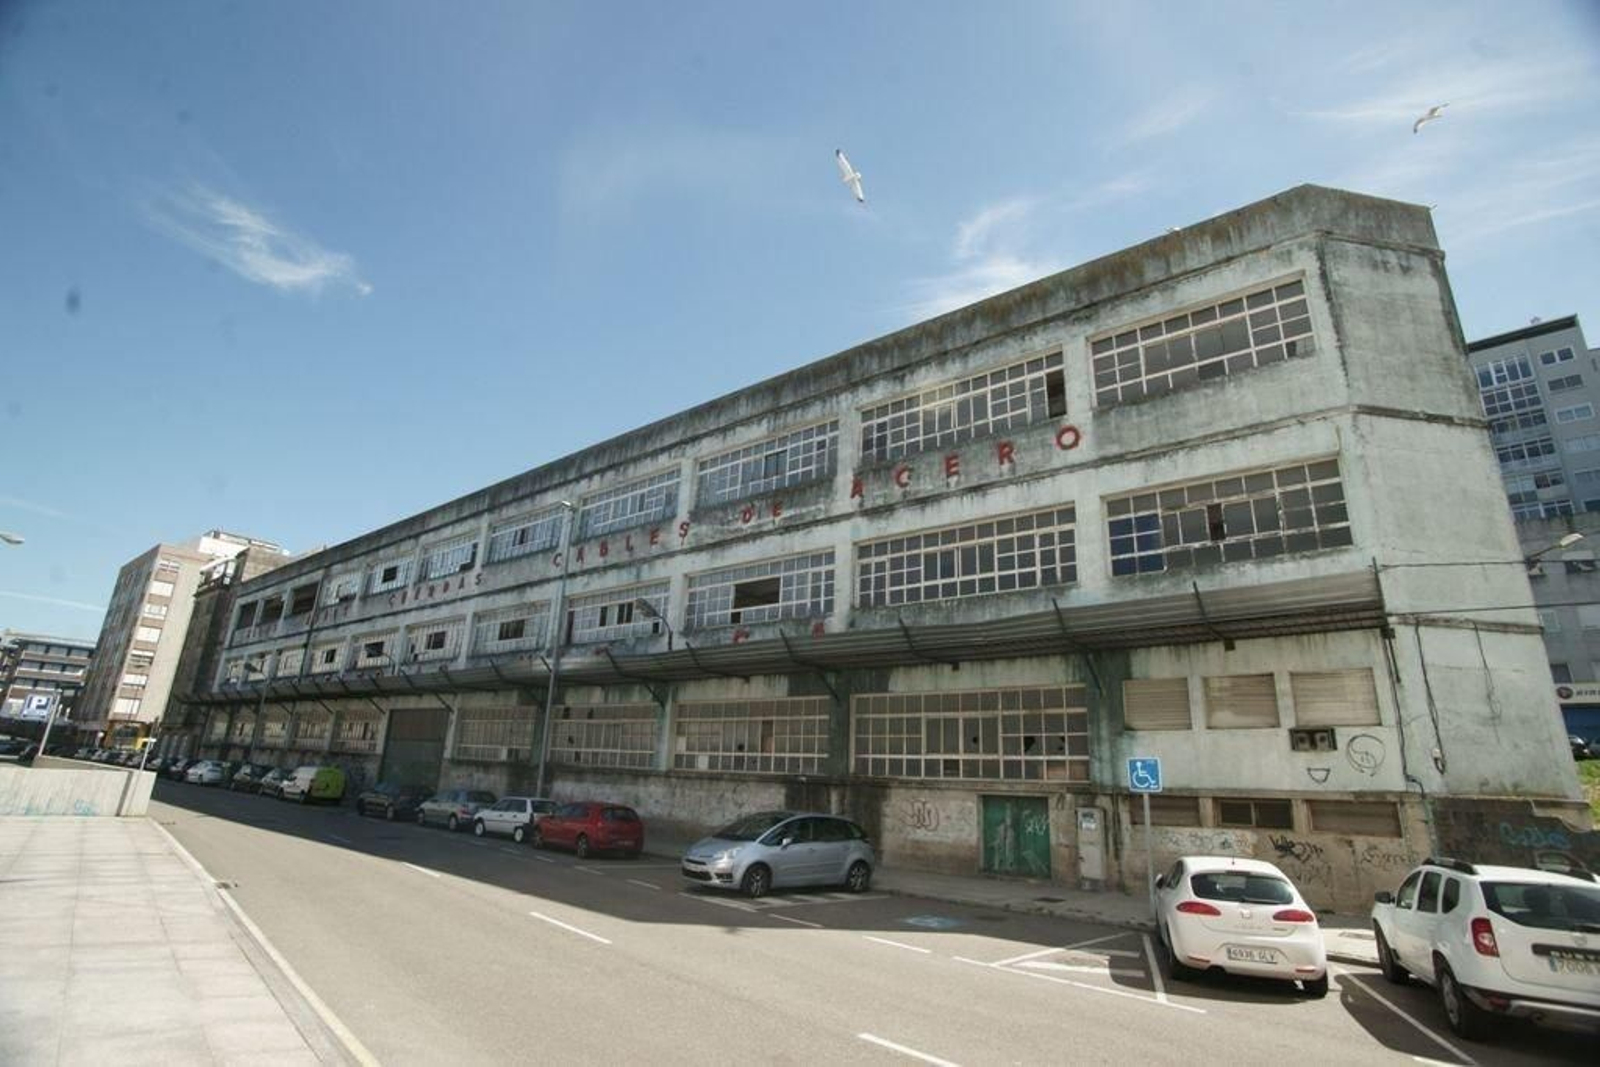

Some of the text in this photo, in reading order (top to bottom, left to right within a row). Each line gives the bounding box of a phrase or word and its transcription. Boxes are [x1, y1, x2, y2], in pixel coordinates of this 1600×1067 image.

[552, 521, 691, 567] CABLES
[741, 501, 784, 523] DE
[850, 425, 1082, 499] ACERO
